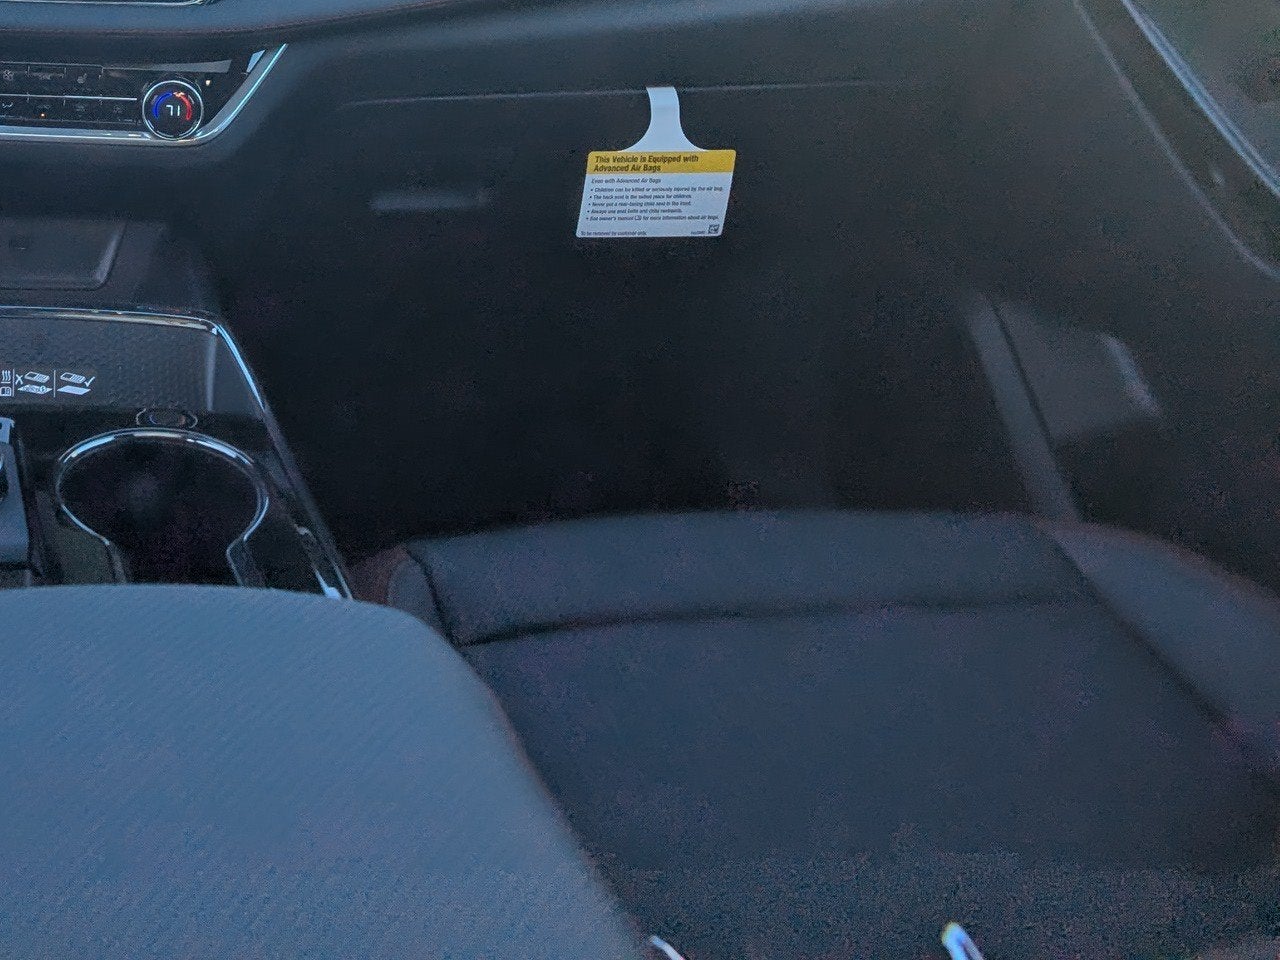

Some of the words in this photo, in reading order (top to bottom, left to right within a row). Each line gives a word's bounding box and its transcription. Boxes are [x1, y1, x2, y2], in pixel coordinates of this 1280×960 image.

[613, 155, 638, 163] Vehicle
[648, 155, 681, 164] Equipped
[593, 164, 630, 172] Advanced
[630, 164, 642, 172] Air
[643, 164, 661, 173] Bags
